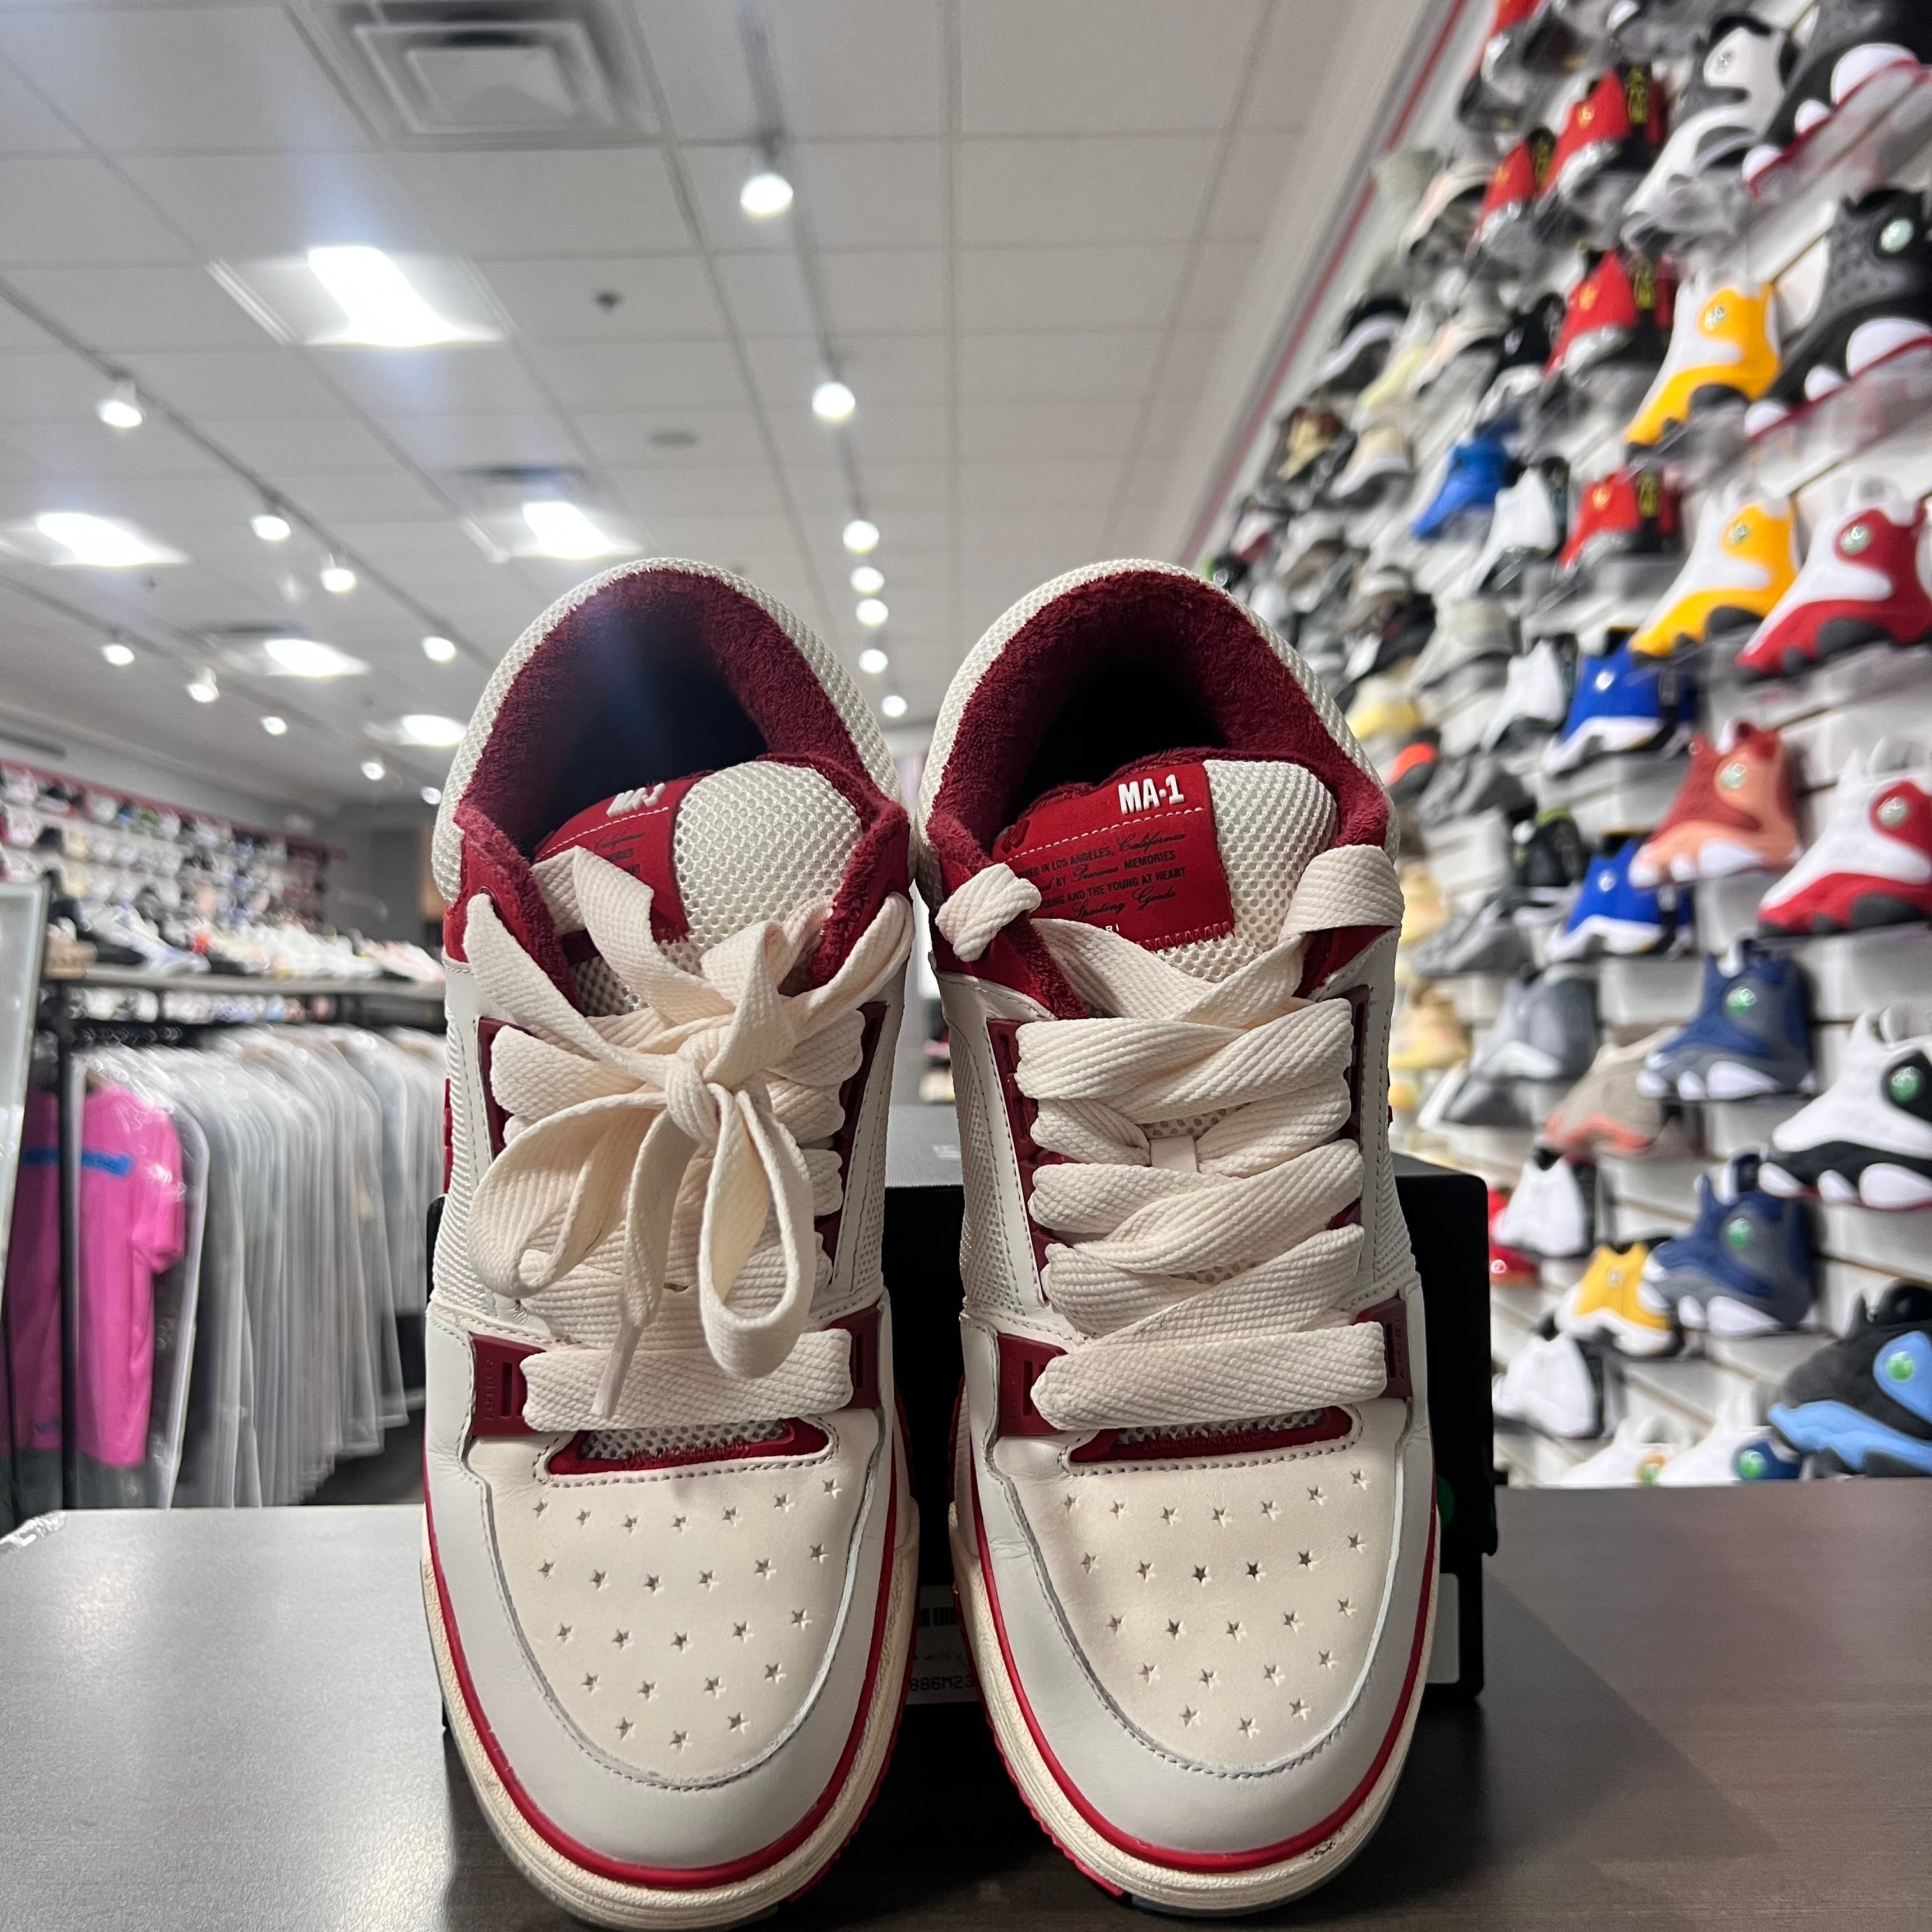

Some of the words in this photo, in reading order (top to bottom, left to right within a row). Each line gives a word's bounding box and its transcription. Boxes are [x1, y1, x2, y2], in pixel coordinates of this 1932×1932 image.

[1117, 774, 1185, 815] MA-1
[1041, 862, 1050, 873] IN
[1052, 858, 1068, 869] LOS
[1117, 831, 1186, 852] California
[1056, 877, 1066, 887] BY
[1124, 850, 1176, 870] MEMORIES
[1068, 889, 1085, 903] AND
[1087, 884, 1105, 896] THE
[1107, 877, 1139, 892] YOUNG
[1142, 873, 1152, 885] AT
[1155, 866, 1186, 882] HEART
[1131, 885, 1176, 911] Goods
